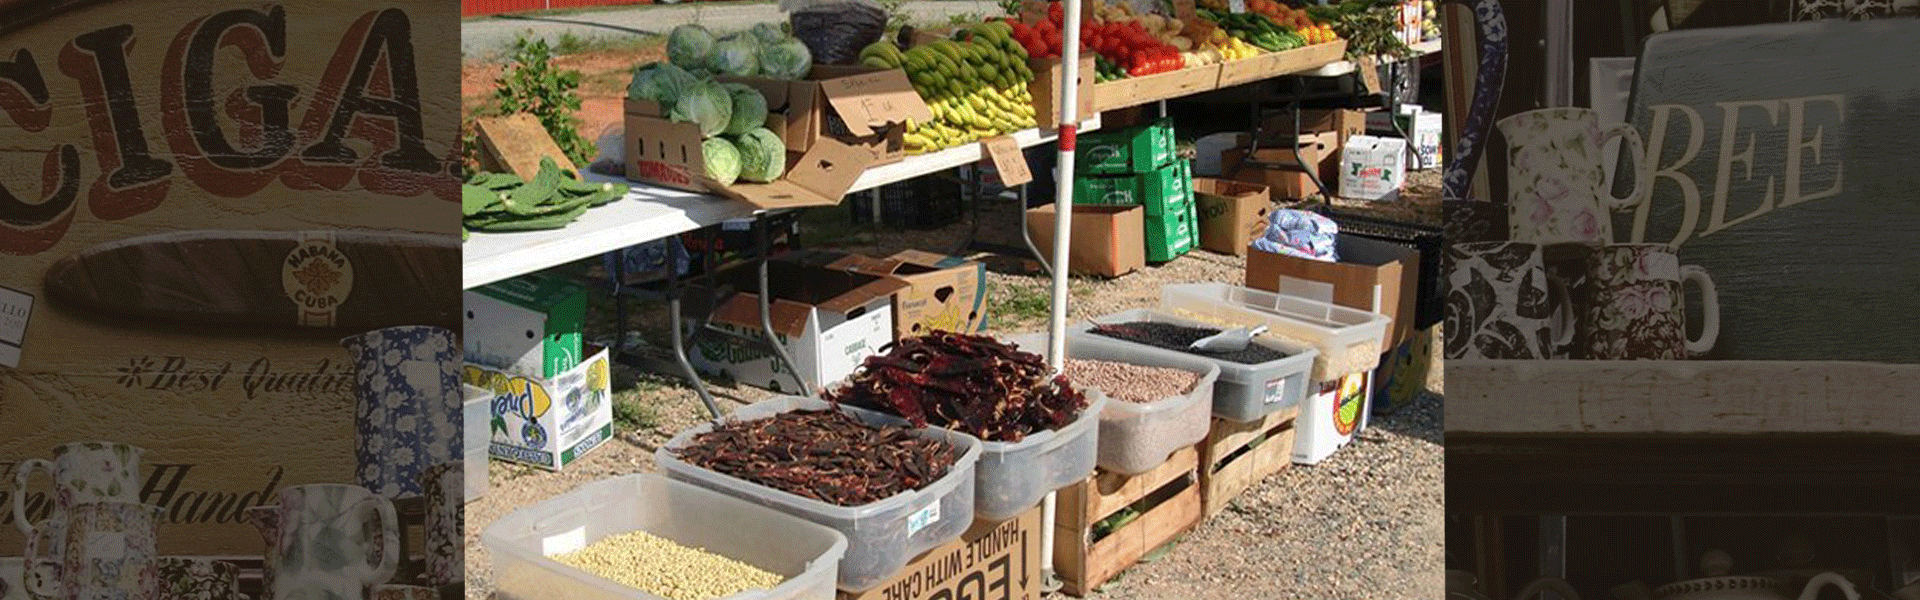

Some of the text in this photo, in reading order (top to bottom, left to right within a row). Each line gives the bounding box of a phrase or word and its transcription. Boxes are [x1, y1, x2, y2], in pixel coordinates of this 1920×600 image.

[1631, 94, 1846, 249] BEE
[287, 245, 345, 269] HABANA
[294, 289, 338, 309] CUBA
[145, 354, 354, 400] Best Qualit
[965, 517, 1020, 569] HANDLE
[882, 570, 922, 600] CARE
[924, 549, 962, 592] WITH
